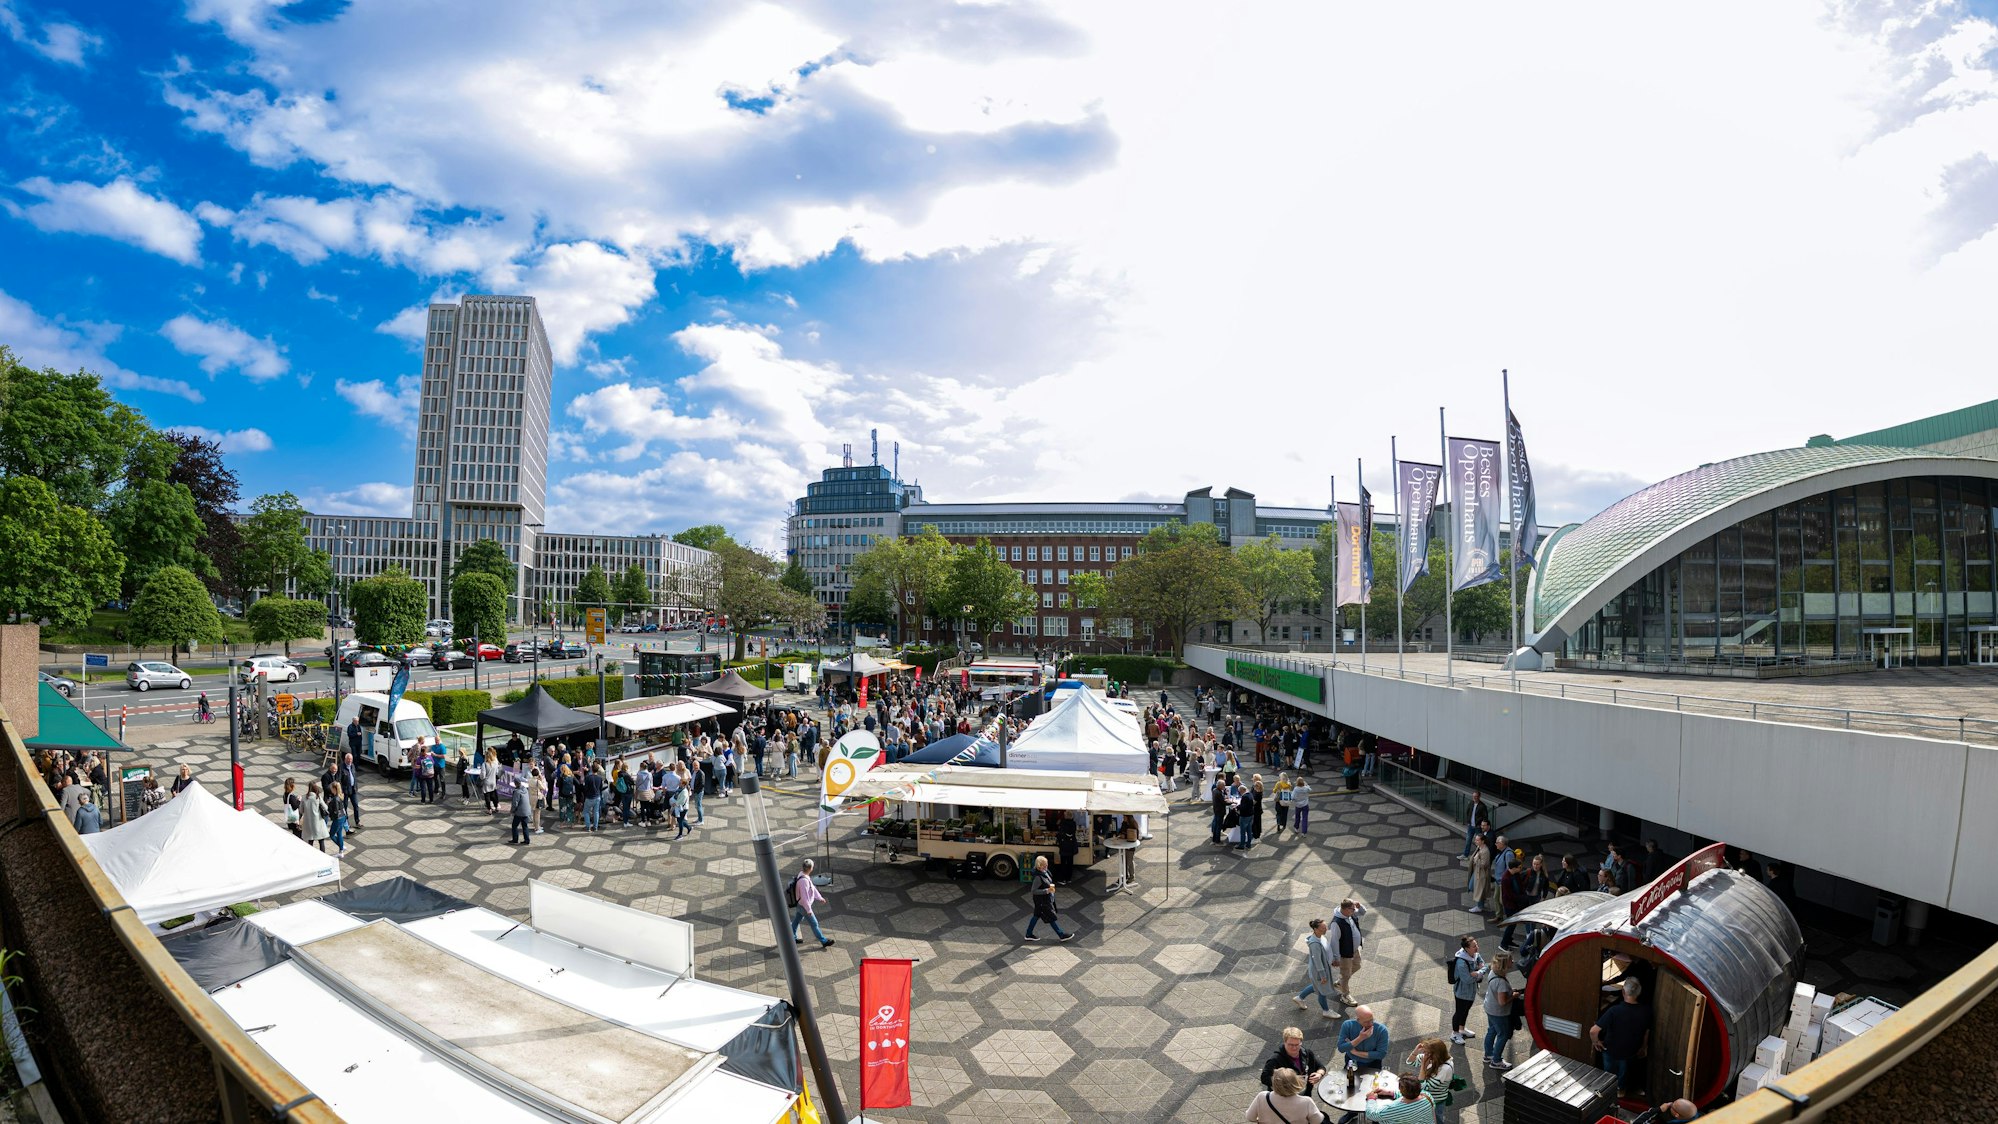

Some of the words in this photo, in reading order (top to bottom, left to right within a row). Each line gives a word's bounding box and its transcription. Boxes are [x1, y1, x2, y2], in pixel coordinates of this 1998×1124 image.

[1424, 469, 1438, 515] Bestes
[1458, 444, 1479, 543] Opernhaus
[1479, 446, 1493, 498] Bestes
[1408, 467, 1424, 553] Opernhaus
[1351, 525, 1361, 587] Dortmund
